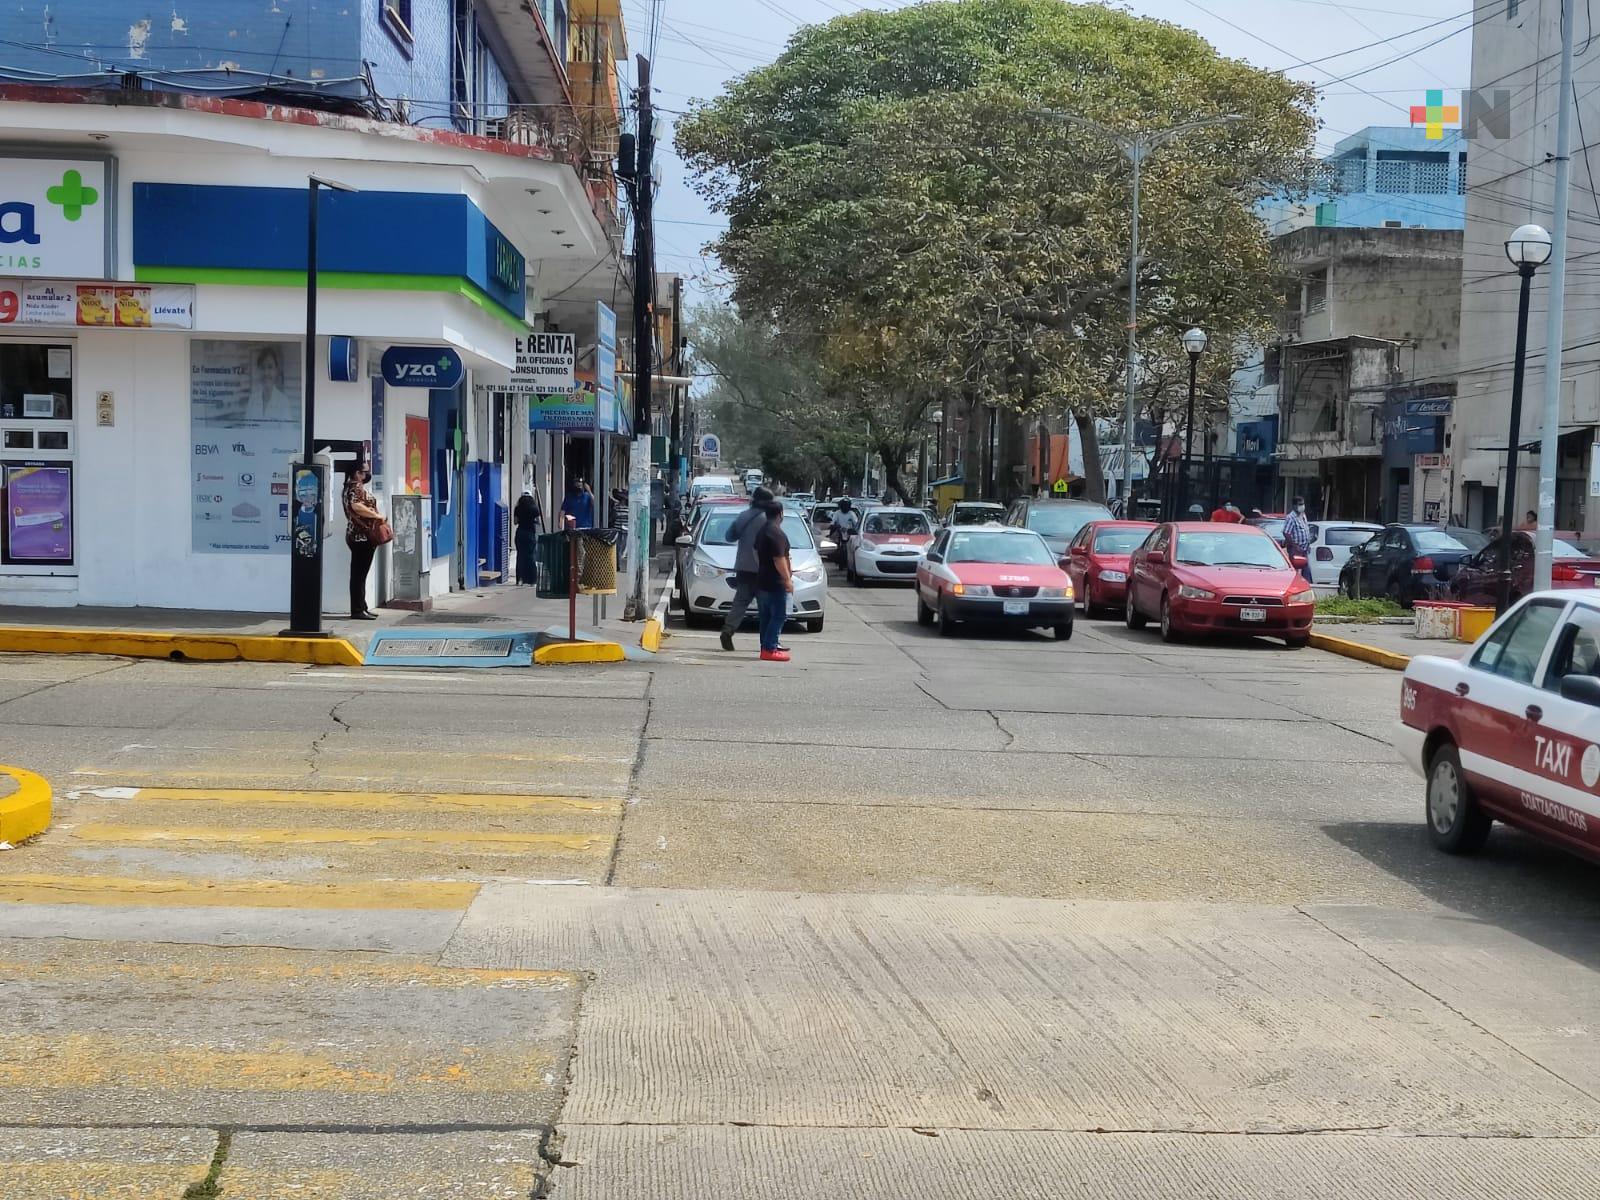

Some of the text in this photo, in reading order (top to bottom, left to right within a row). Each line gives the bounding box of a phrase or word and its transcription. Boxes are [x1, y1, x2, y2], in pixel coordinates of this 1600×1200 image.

[154, 306, 186, 315] Llévate
[527, 334, 574, 355] RENTA
[529, 356, 565, 365] OFICINAS
[394, 363, 437, 379] yza
[195, 444, 220, 455] BBVA
[1534, 735, 1574, 778] TAXI
[1520, 791, 1588, 832] COATZACOALCOS
